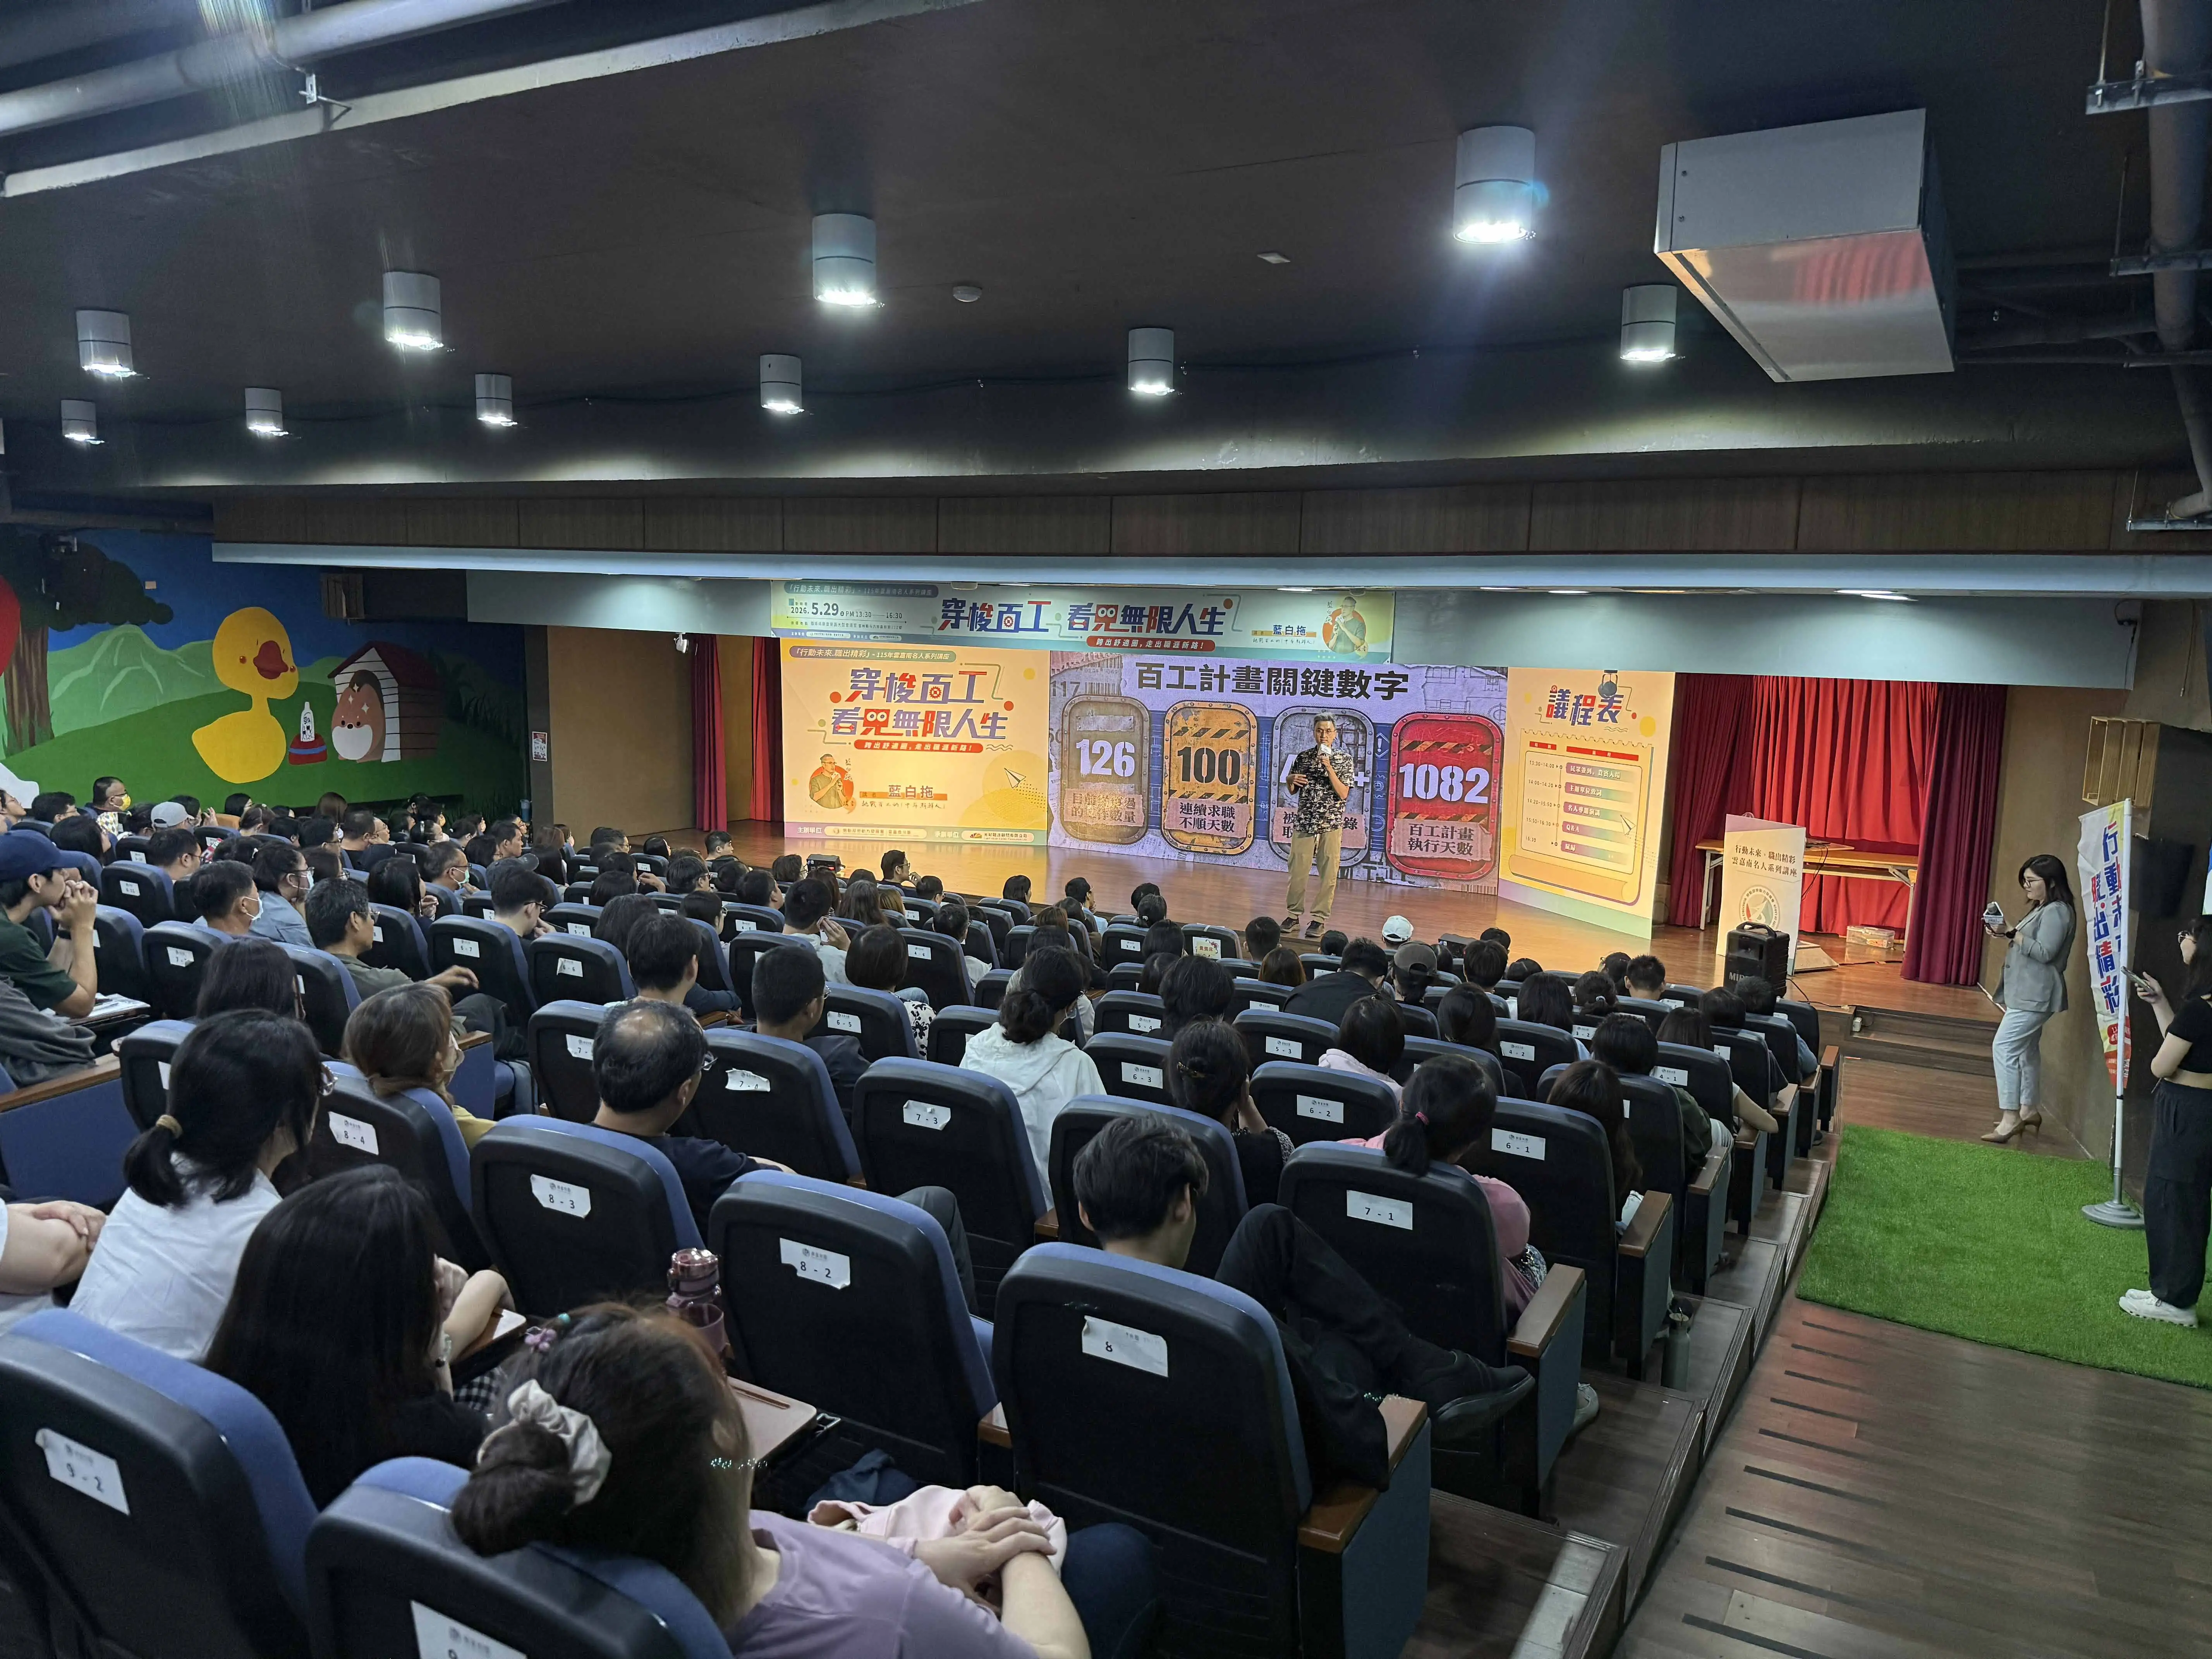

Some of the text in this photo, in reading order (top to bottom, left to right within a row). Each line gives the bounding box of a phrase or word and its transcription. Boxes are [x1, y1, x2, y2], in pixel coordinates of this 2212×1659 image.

[811, 602, 839, 616] 5.29
[938, 598, 1226, 636] 穿梭百工 看見無限人生
[1273, 625, 1306, 636] 藍白拖
[845, 667, 988, 704] 穿梭百工
[1135, 662, 1409, 701] 百工計畫關鍵數字
[1546, 685, 1625, 726] 議程表
[832, 707, 1008, 739] 看見無限人生
[1076, 739, 1135, 777] 126
[1177, 746, 1241, 786] 100
[888, 785, 934, 798] 藍白拖
[1399, 763, 1490, 804] 1082
[1180, 802, 1236, 819] 連續求職
[1179, 817, 1235, 833] 不順天數
[1409, 823, 1474, 842] 百工計畫
[1566, 824, 1580, 833] Q&A
[1408, 837, 1474, 856] 執行天數
[1732, 856, 1797, 878] 雲嘉南名人系列講座
[344, 1130, 349, 1139] 8
[361, 1136, 365, 1144] 4
[549, 1194, 554, 1203] 8
[570, 1200, 575, 1209] 3
[1388, 1212, 1394, 1221] 1
[800, 1261, 806, 1271] 8
[825, 1268, 831, 1278] 2
[1106, 1341, 1113, 1352] 8
[67, 1463, 74, 1477] 9
[94, 1477, 102, 1491] 2
